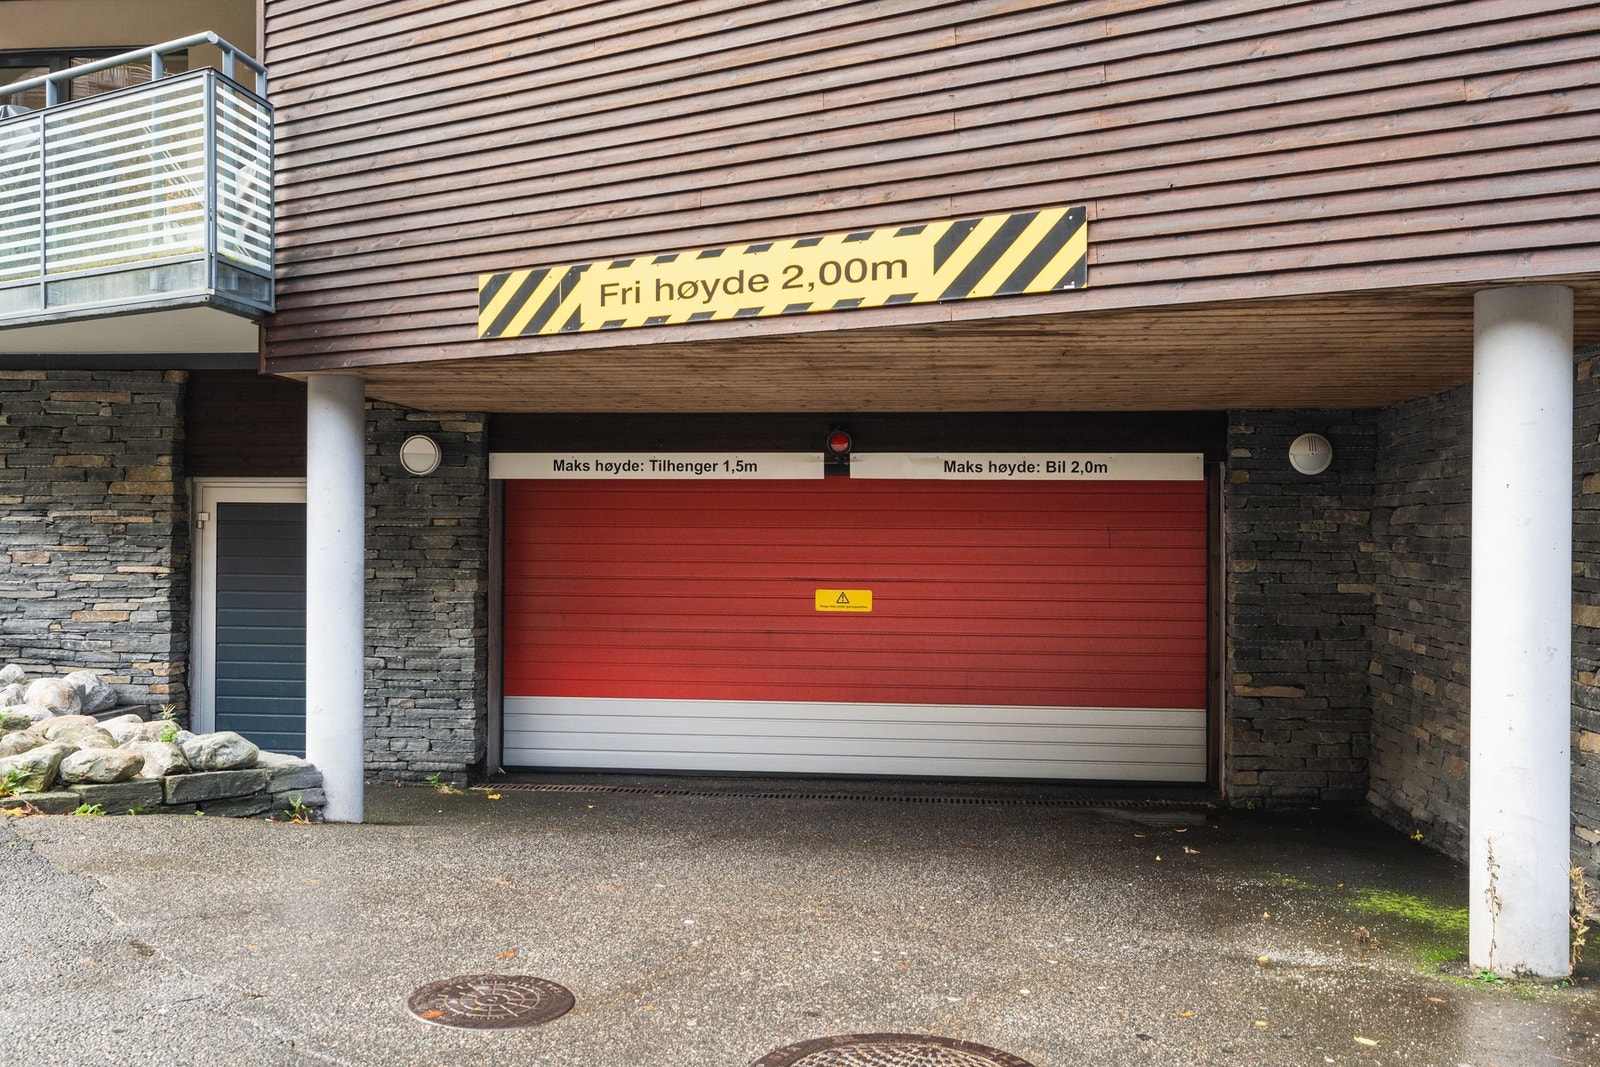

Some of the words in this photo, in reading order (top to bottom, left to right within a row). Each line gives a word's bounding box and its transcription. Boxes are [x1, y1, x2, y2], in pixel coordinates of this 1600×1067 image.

[600, 280, 640, 307] Fri
[655, 269, 769, 304] høyde
[781, 258, 907, 293] 2,00m
[553, 459, 591, 472] Maks
[595, 459, 644, 475] høyde:
[648, 459, 719, 476] Tilhenger
[723, 459, 758, 475] 1,5m
[943, 460, 983, 473] Maks
[988, 460, 1040, 477] høyde:
[1045, 460, 1066, 473] Bil
[1070, 460, 1108, 476] 2,0m
